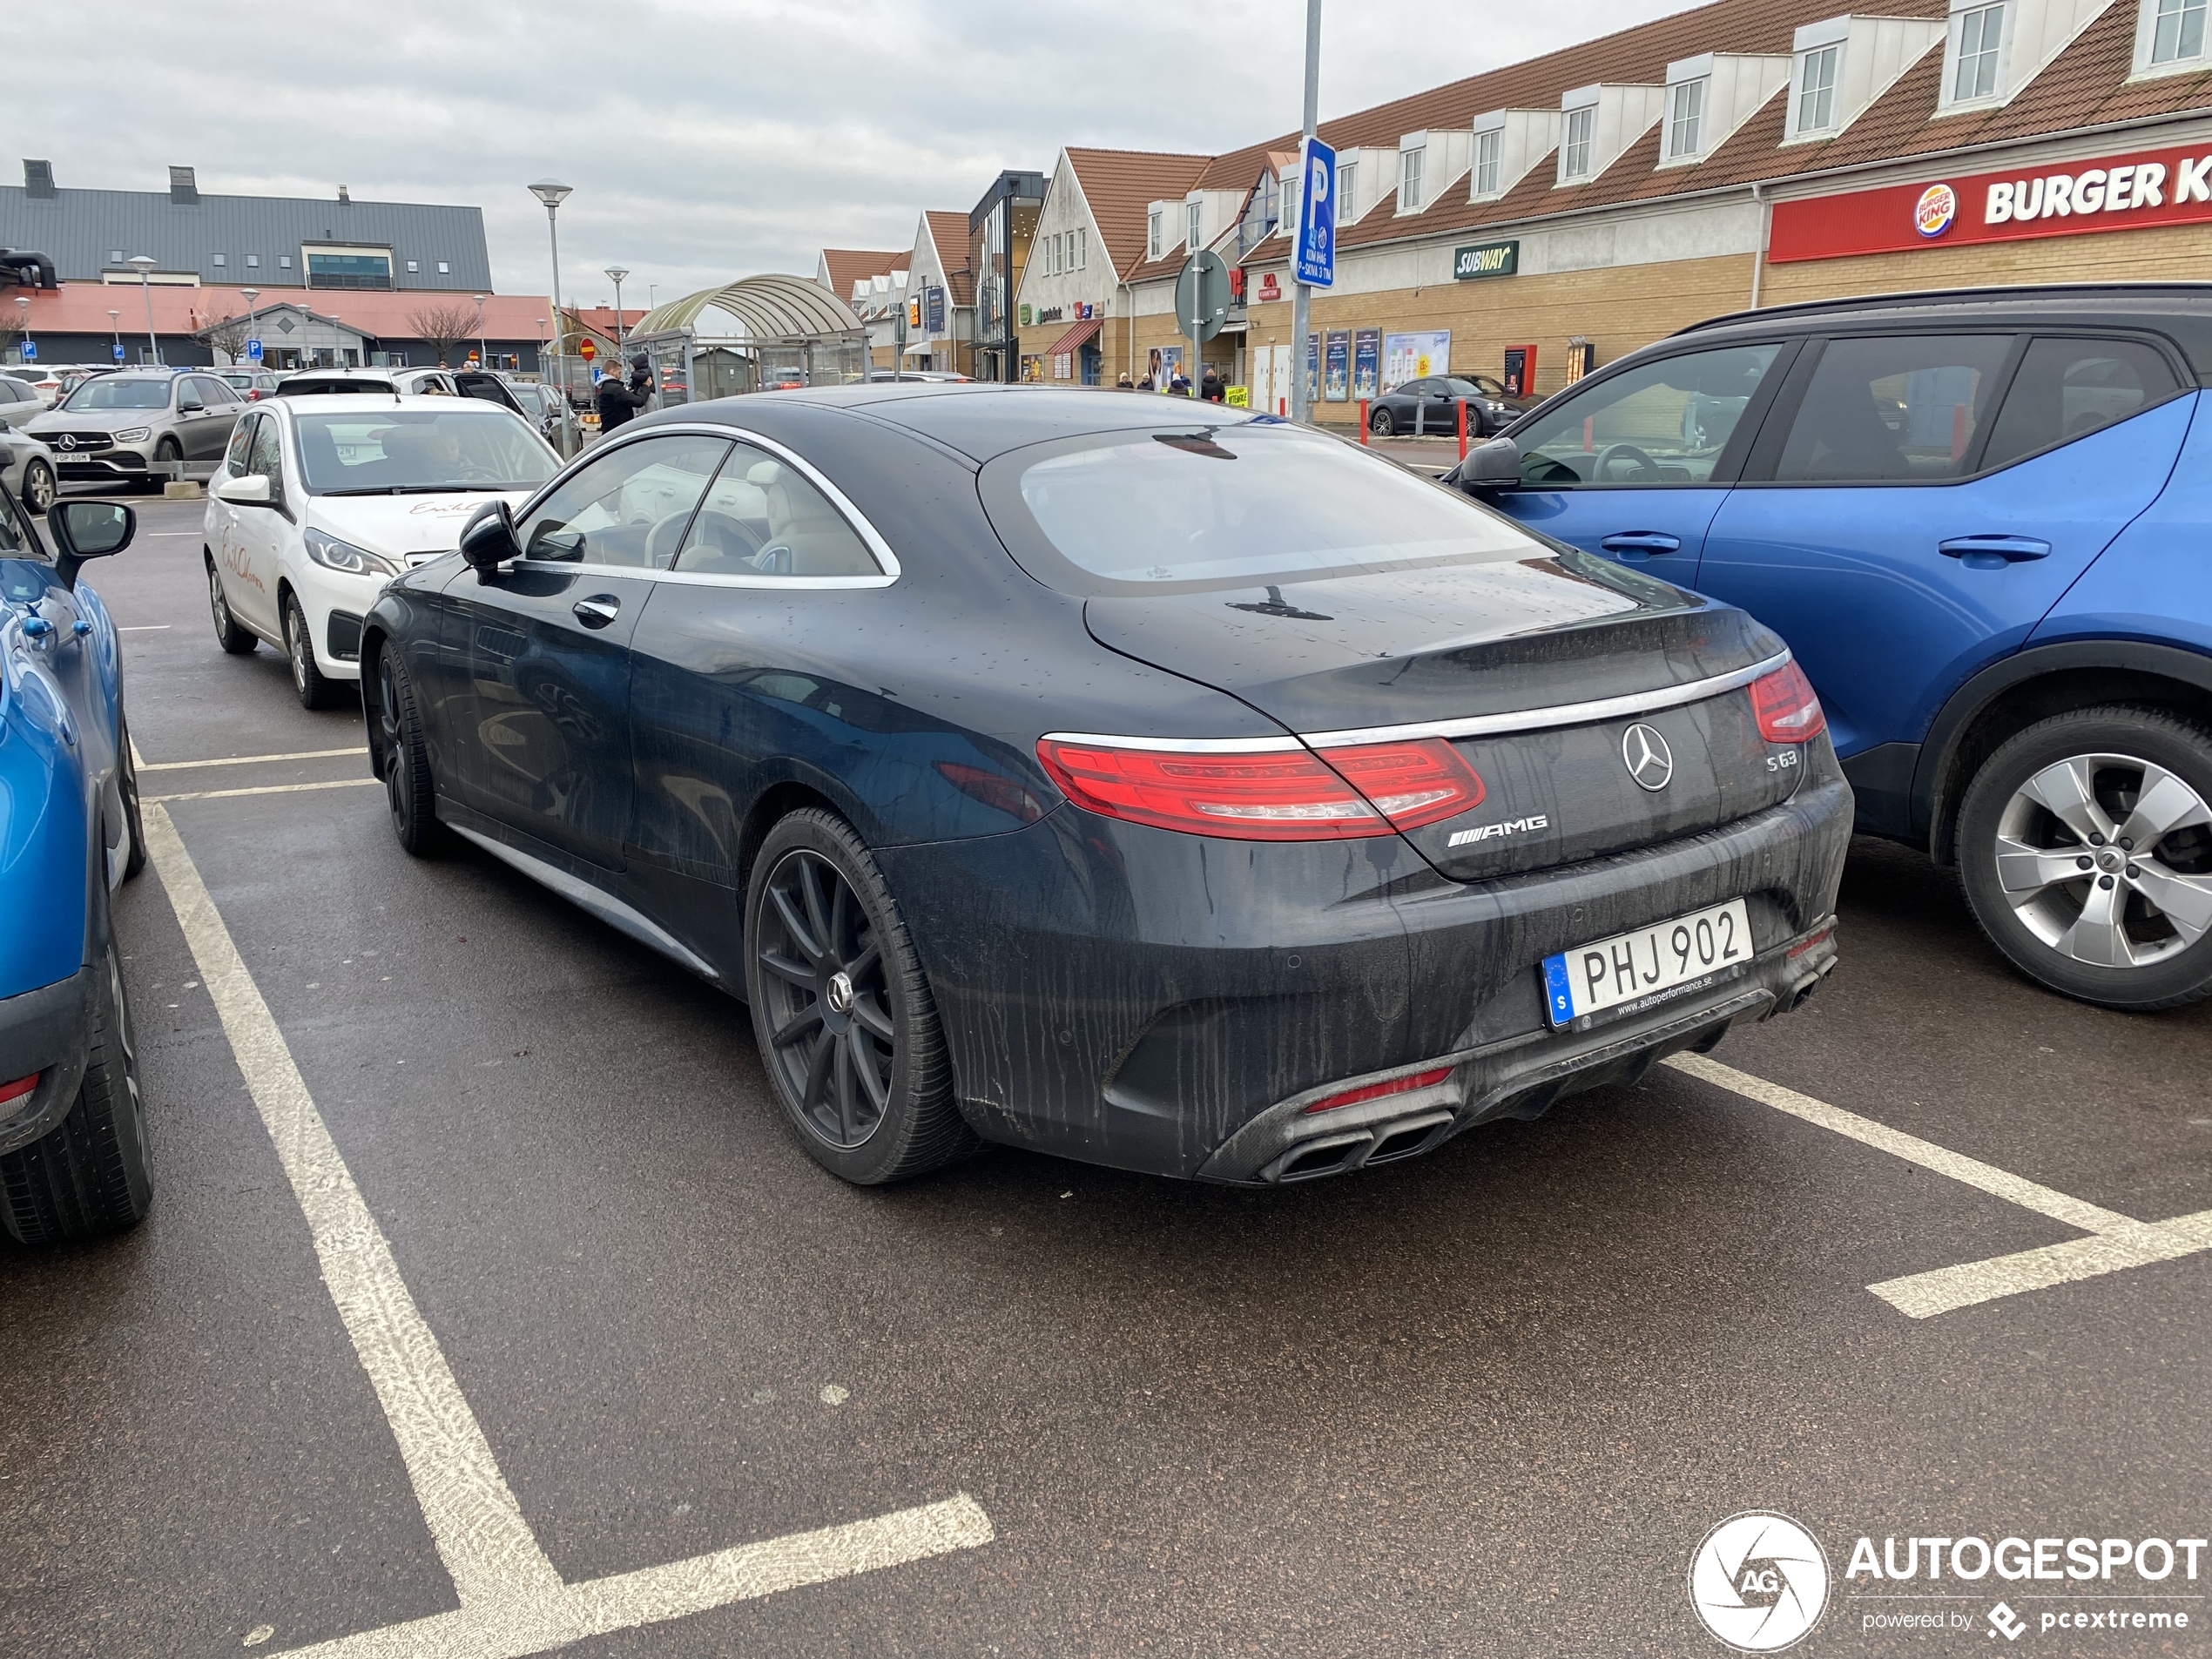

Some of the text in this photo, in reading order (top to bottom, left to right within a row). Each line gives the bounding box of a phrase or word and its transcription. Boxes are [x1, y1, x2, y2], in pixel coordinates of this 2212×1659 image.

[1309, 156, 1329, 229] P
[1985, 155, 2212, 224] BURGER K
[1919, 192, 1951, 214] BURGER
[1919, 200, 1952, 226] KING
[1318, 266, 1323, 279] 3
[1457, 246, 1511, 274] SUBWAY
[25, 344, 33, 354] P
[250, 341, 260, 354] P
[1767, 750, 1798, 772] S 63
[1480, 814, 1548, 841] AMG
[1583, 911, 1739, 1004] PHJ 902
[1557, 995, 1567, 1010] S
[1617, 975, 1713, 1015] www.autoperformance.se
